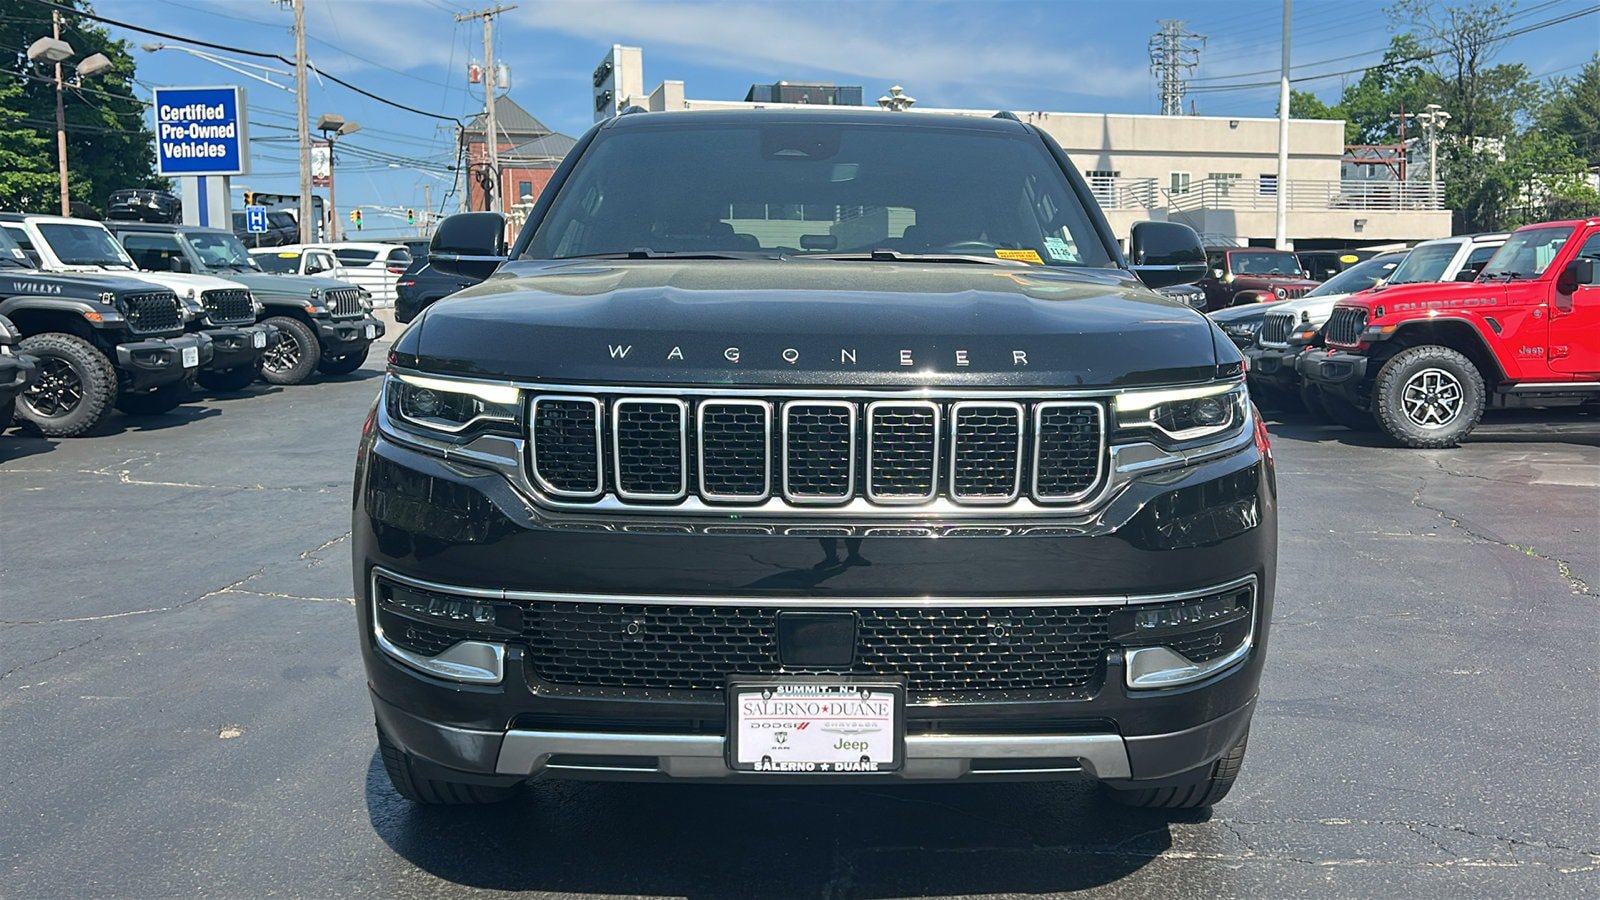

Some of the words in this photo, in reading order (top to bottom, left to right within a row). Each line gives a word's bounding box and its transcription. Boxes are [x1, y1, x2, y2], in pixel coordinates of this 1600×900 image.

[160, 104, 224, 121] Certified
[161, 122, 235, 140] Pre-Owned
[162, 141, 226, 159] Vehicles
[251, 211, 262, 225] H
[13, 282, 63, 294] WILLYS
[1393, 298, 1496, 310] RUBICON
[607, 344, 1029, 366] WAGONEER
[1518, 345, 1544, 356] Jeep
[776, 685, 832, 694] SUMMIT,
[839, 685, 857, 694] NJ
[743, 702, 820, 716] SALERNO
[830, 702, 889, 717] DUANE
[833, 738, 869, 752] Jeep
[753, 762, 815, 772] SALERNO
[834, 762, 878, 772] DUANE
